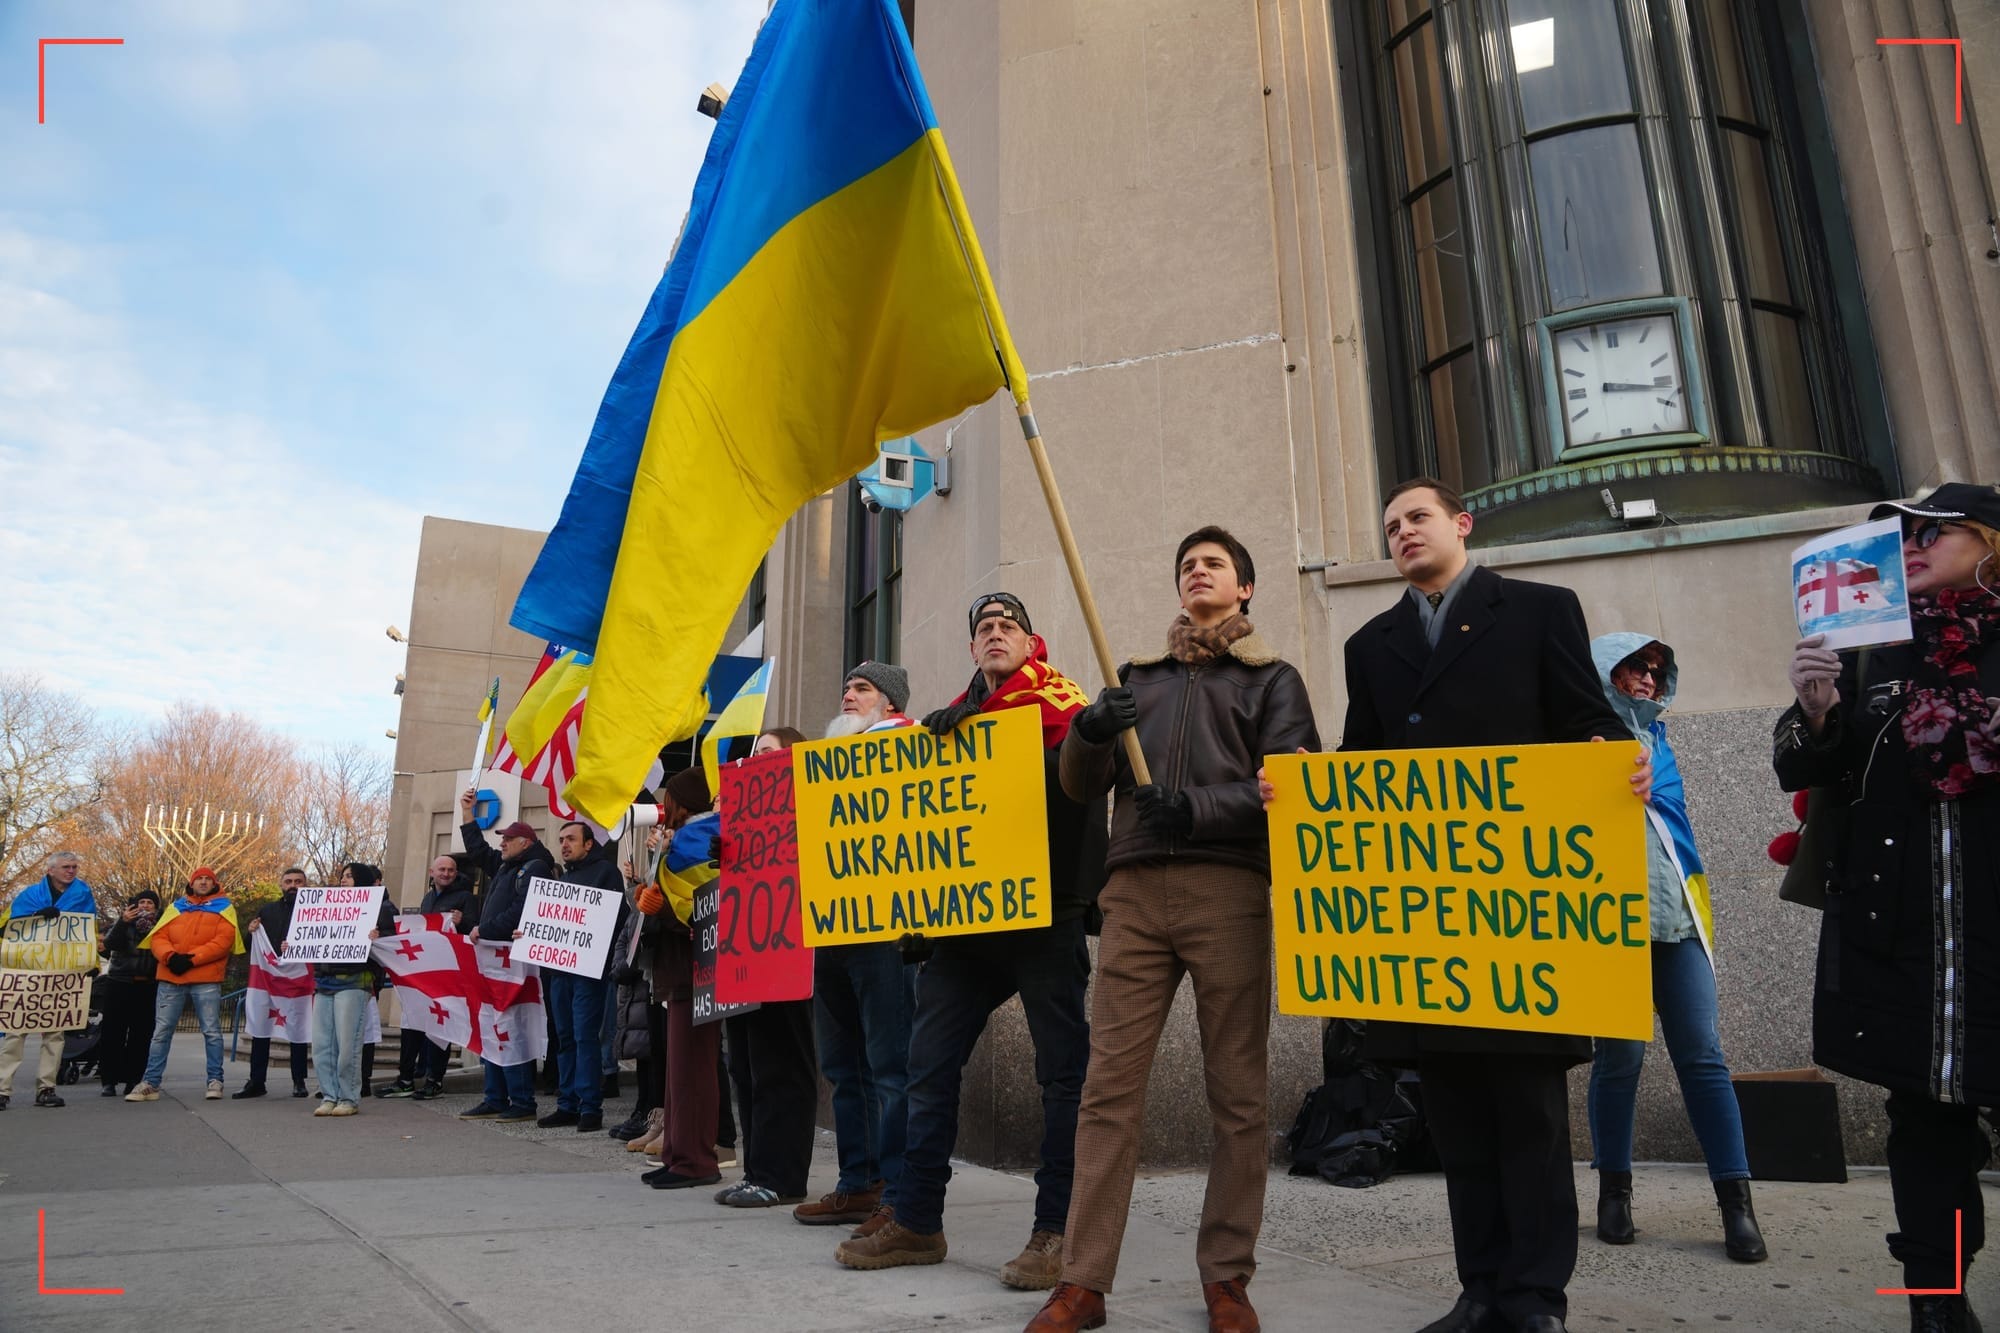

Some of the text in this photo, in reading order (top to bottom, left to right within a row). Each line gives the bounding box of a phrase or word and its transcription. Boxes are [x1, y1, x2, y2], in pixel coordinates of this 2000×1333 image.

[804, 720, 998, 784] INDEPENDENT
[1301, 755, 1525, 813] UKRAINE
[829, 774, 987, 827] AND FREE,
[825, 825, 977, 880] UKRAINE
[1295, 820, 1604, 884] DEFINES US,
[298, 889, 370, 904] STOP RUSSIAN
[533, 880, 603, 906] FREEDOM FOR
[809, 877, 1038, 935] WILL ALWAYS BE
[8, 915, 92, 943] SUPPORT
[719, 875, 802, 956] 202
[1294, 885, 1646, 947] INDEPENDENCE
[294, 925, 356, 941] STAND WITH
[523, 921, 593, 949] FREEDOM FOR
[4, 942, 94, 970] UKRAINE!
[322, 944, 330, 959] &
[331, 944, 367, 960] GEORGIA
[528, 944, 577, 968] GEORGIA
[0, 972, 89, 992] DESTROY
[1295, 953, 1560, 1017] UNITES US
[0, 991, 83, 1011] FASCIST
[693, 993, 712, 1019] HAS
